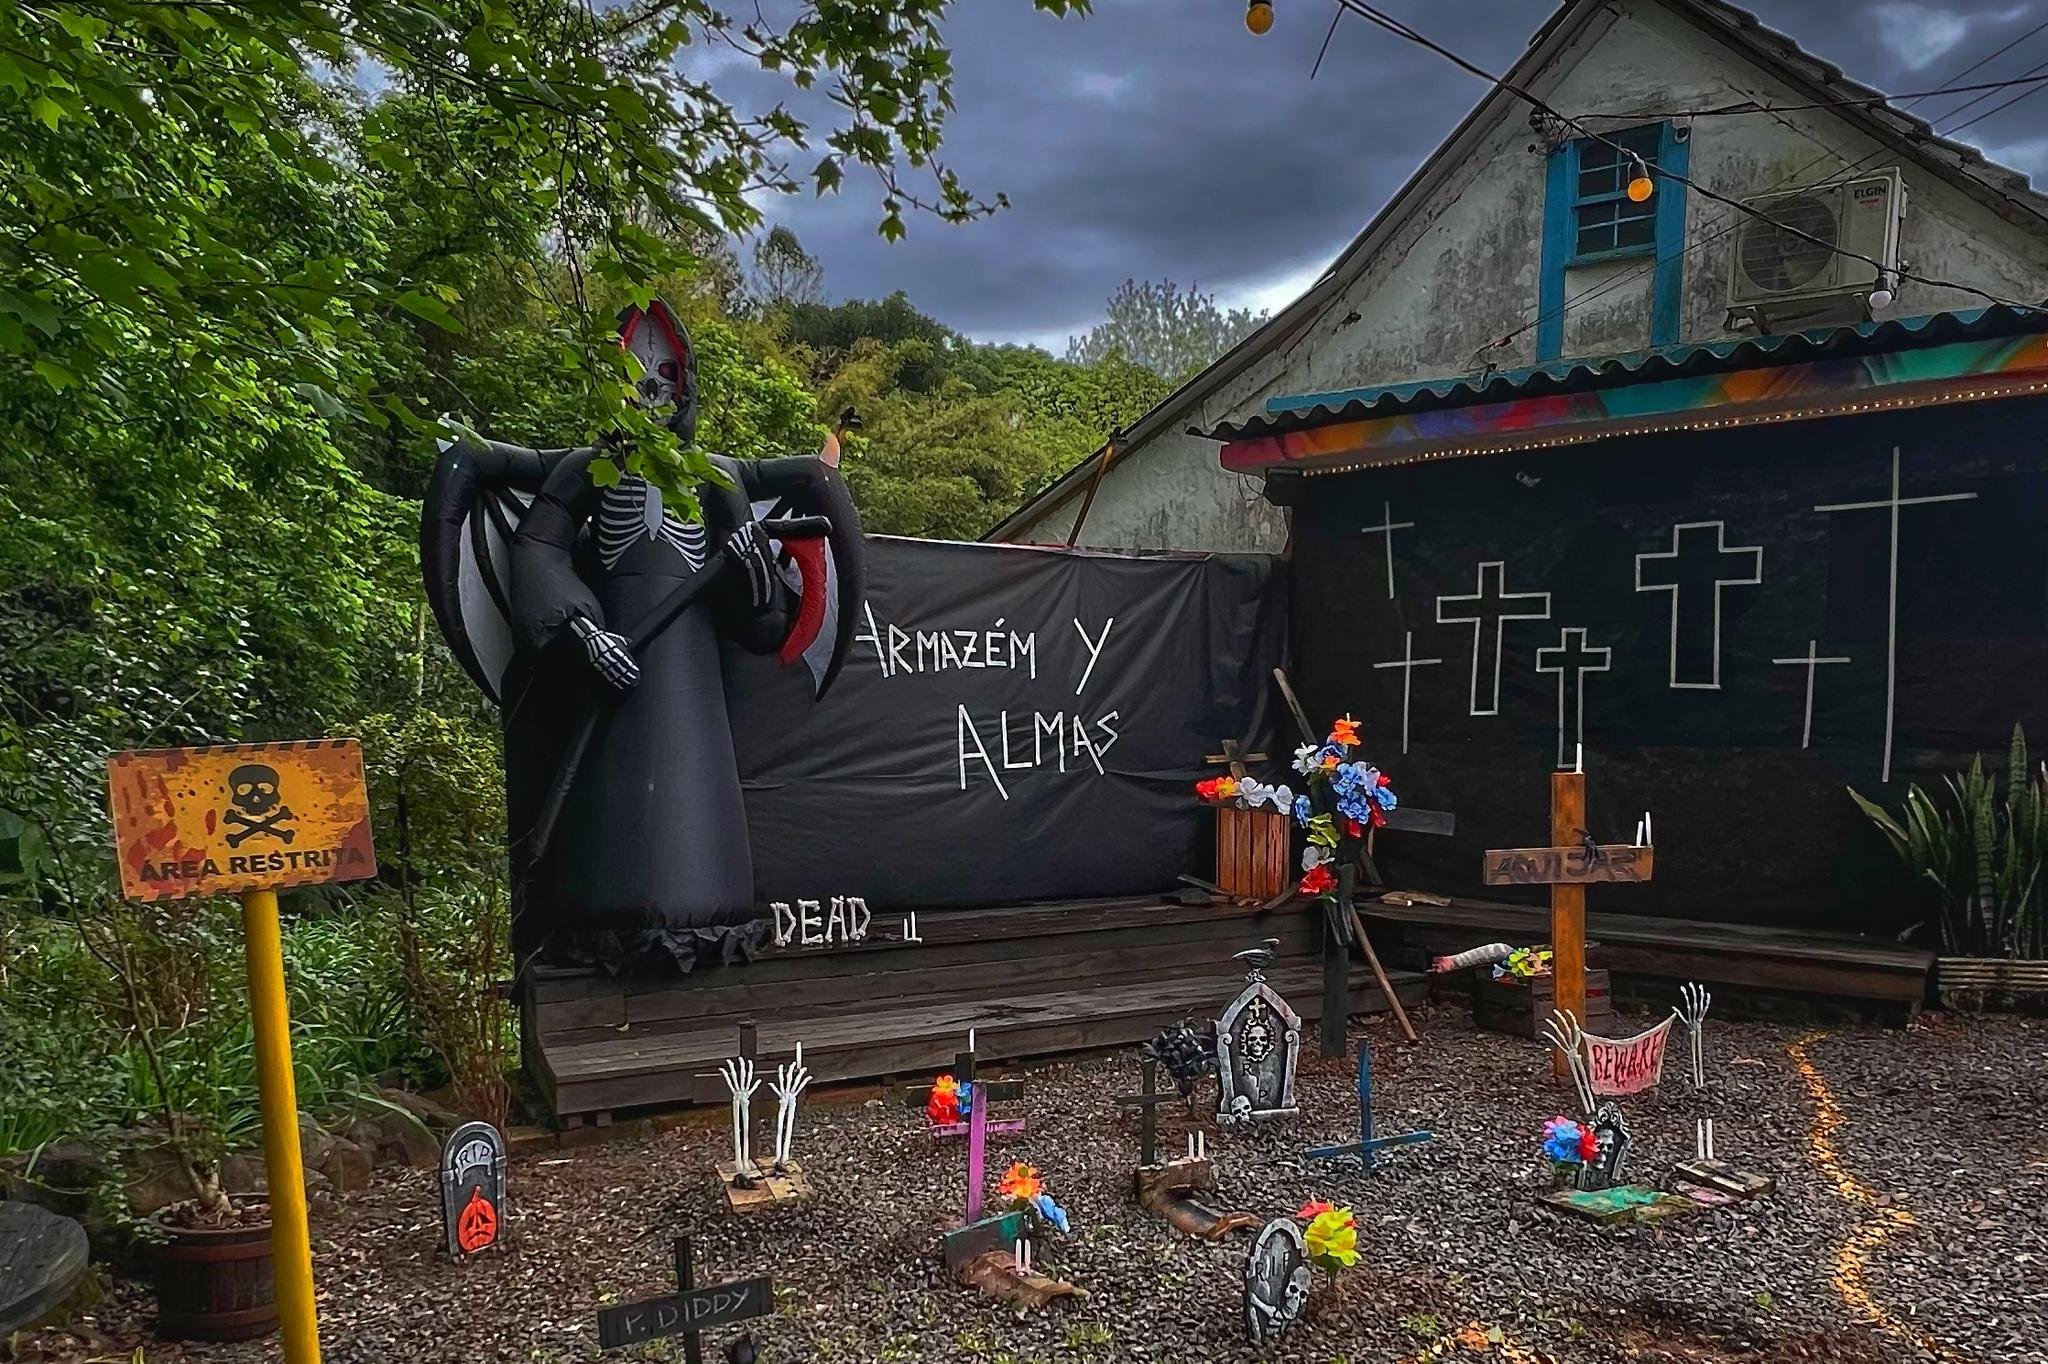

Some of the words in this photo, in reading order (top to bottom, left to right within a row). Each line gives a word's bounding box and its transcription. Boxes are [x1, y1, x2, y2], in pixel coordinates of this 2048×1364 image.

[1854, 185, 1887, 199] ELGIN
[1073, 617, 1113, 695] Y
[959, 704, 1119, 801] ALMAS
[229, 847, 364, 874] RESTRITA
[770, 895, 871, 947] DEAD
[1592, 1030, 1664, 1087] BEWARE
[459, 1143, 490, 1167] RIP
[1255, 1251, 1289, 1281] RIP
[658, 1287, 749, 1329] DIDDY
